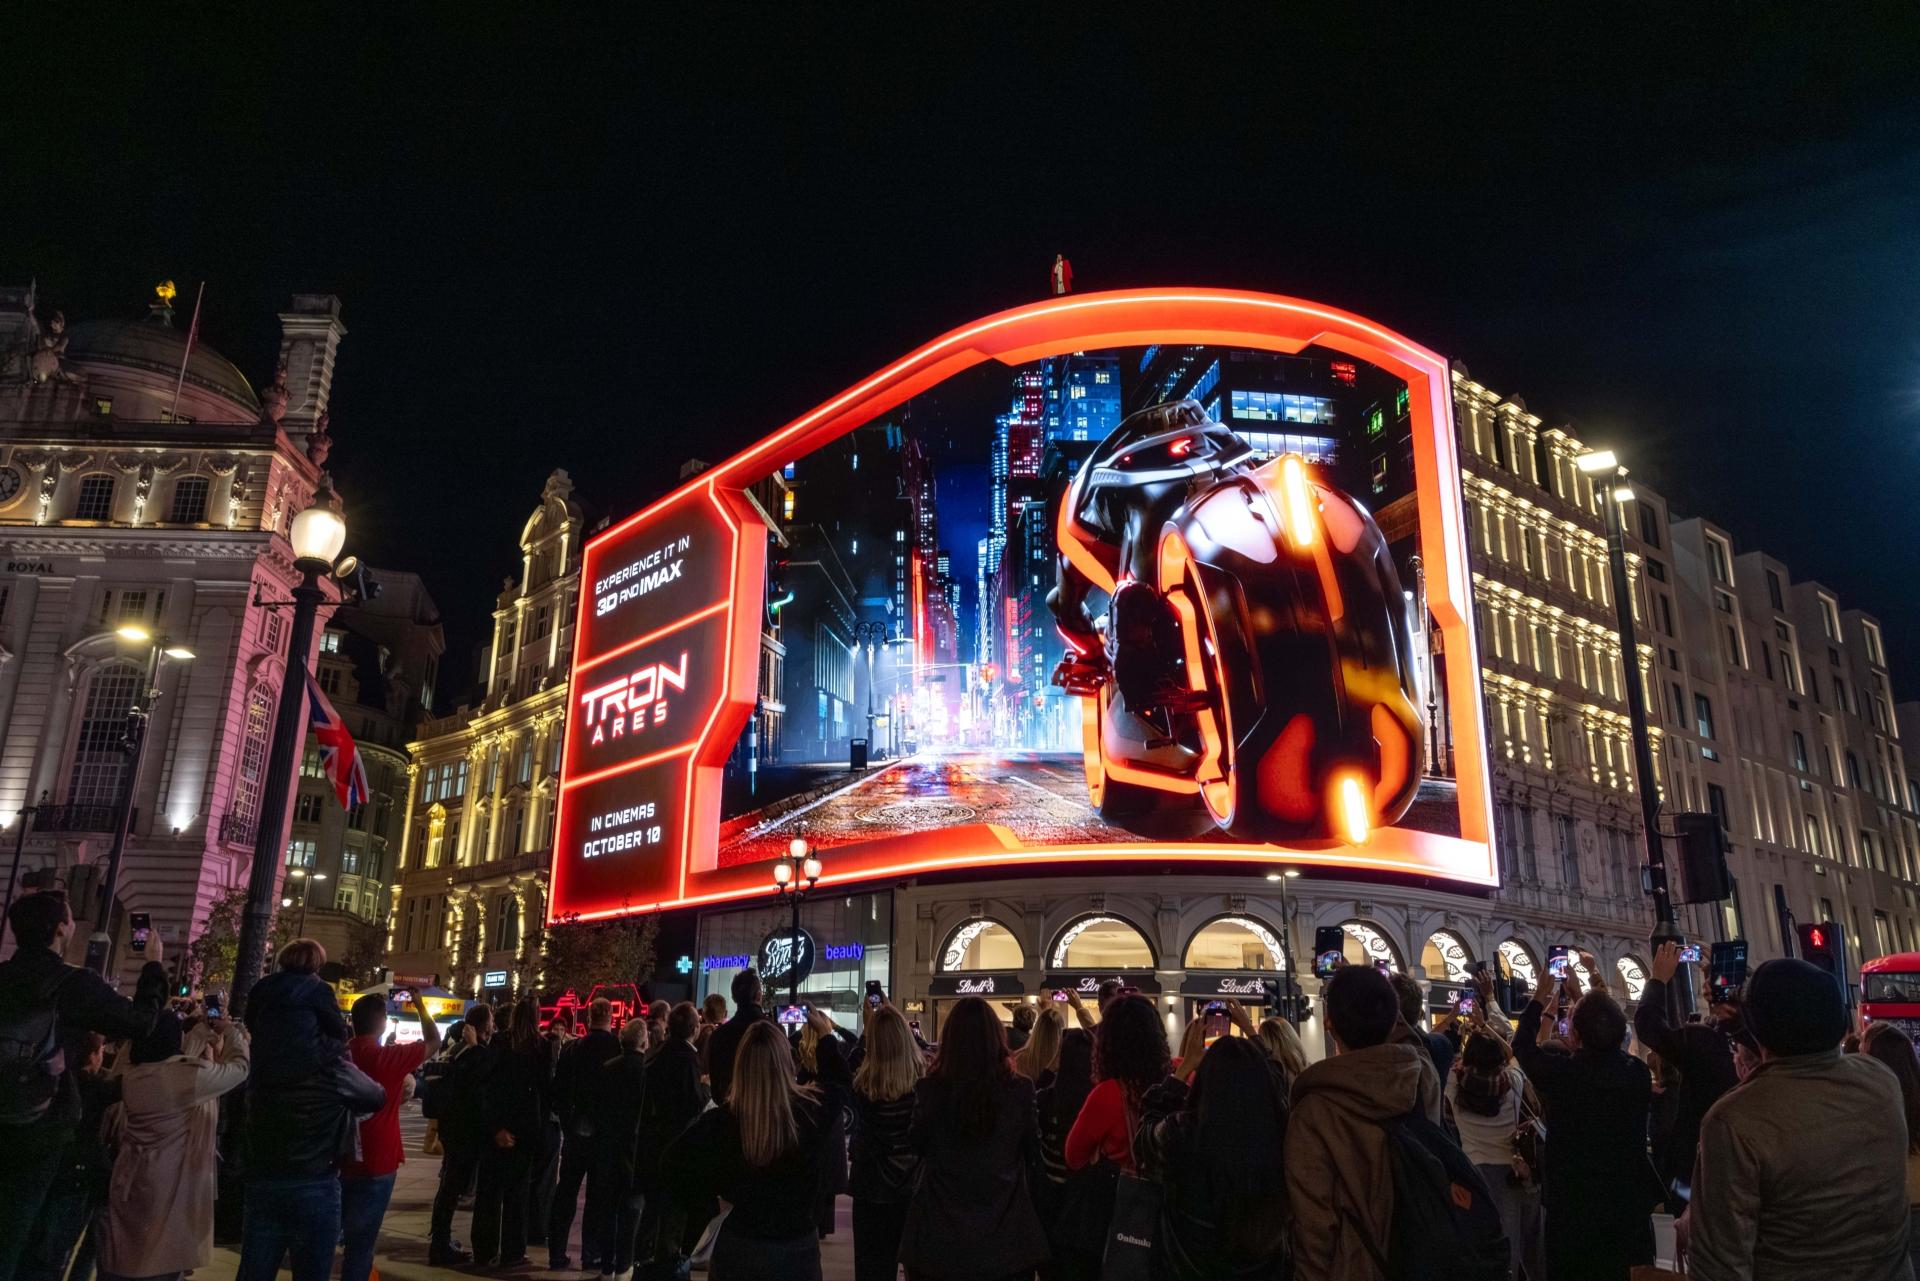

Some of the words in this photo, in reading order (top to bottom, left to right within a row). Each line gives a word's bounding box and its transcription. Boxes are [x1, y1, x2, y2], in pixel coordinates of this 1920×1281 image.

[7, 561, 54, 574] ROYAL
[595, 550, 661, 595] EXPERIENCE
[664, 542, 675, 560] IT
[678, 535, 690, 552] IN
[597, 592, 618, 617] 3D
[619, 583, 640, 604] AND
[640, 559, 683, 596] IMAX
[581, 652, 687, 727] TRON
[591, 700, 667, 745] ARES
[591, 815, 602, 832] IN
[605, 802, 655, 829] CINEMAS
[583, 830, 642, 858] OCTOBER
[647, 826, 661, 845] 10
[703, 955, 749, 974] pharmacy
[826, 942, 864, 960] beauty
[956, 979, 987, 994] Lindt
[1217, 978, 1255, 993] Lindt
